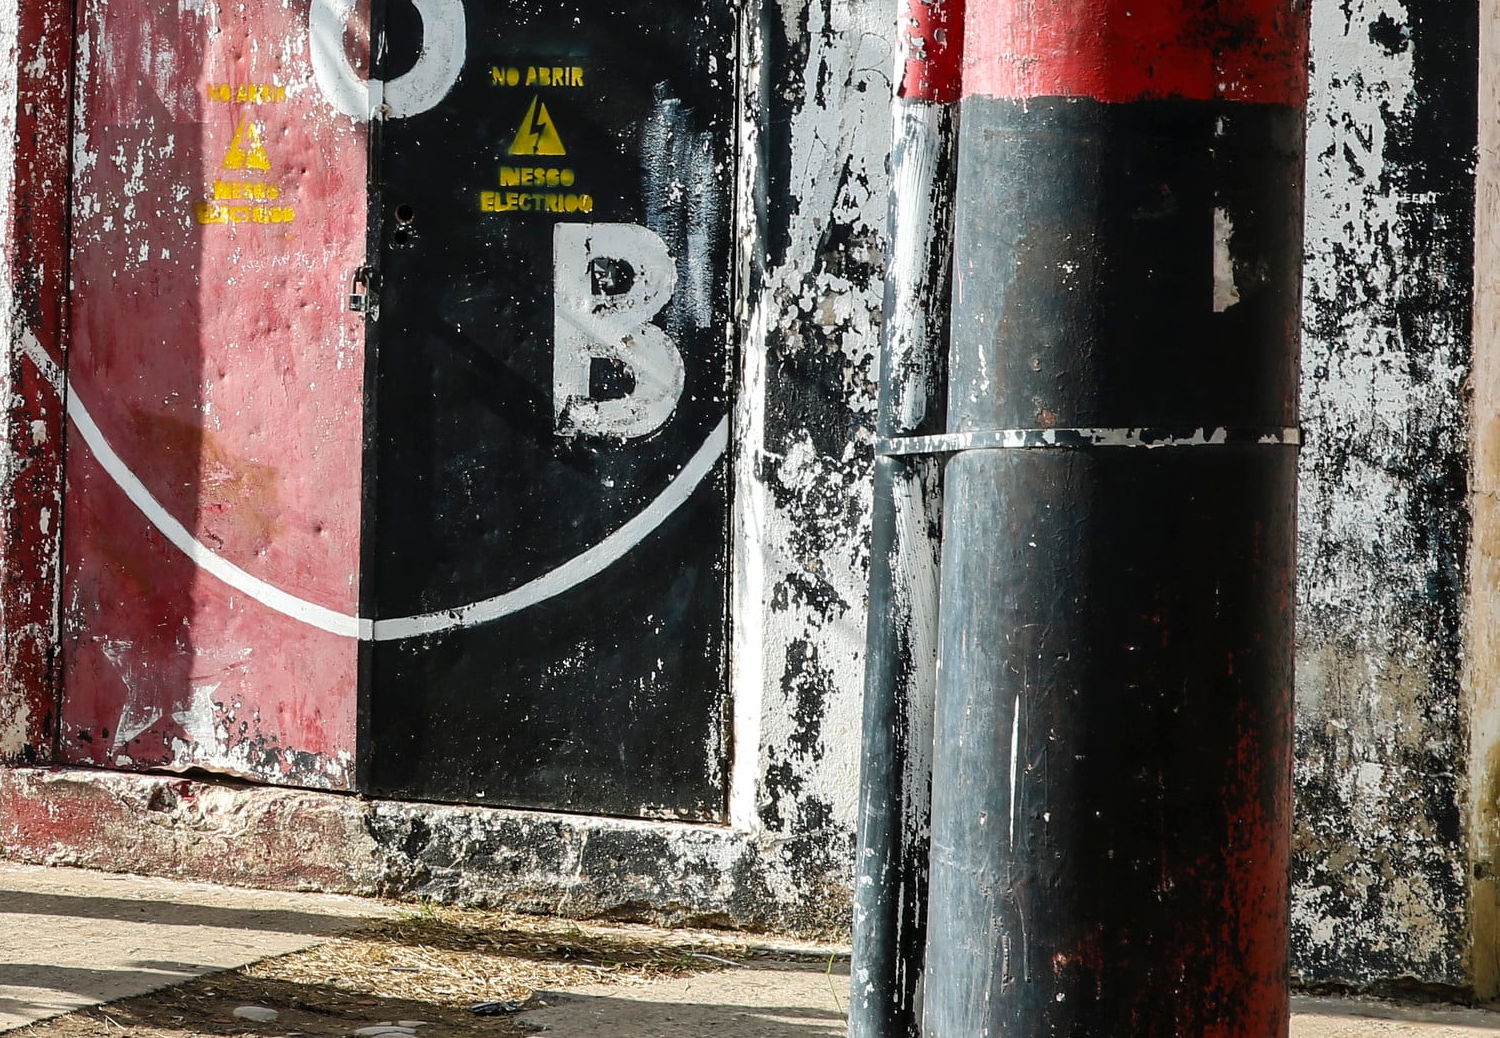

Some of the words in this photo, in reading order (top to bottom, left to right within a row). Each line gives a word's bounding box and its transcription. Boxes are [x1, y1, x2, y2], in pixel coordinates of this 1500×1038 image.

[492, 66, 520, 86] NO
[525, 66, 584, 87] ABRIR
[206, 83, 232, 102] NO
